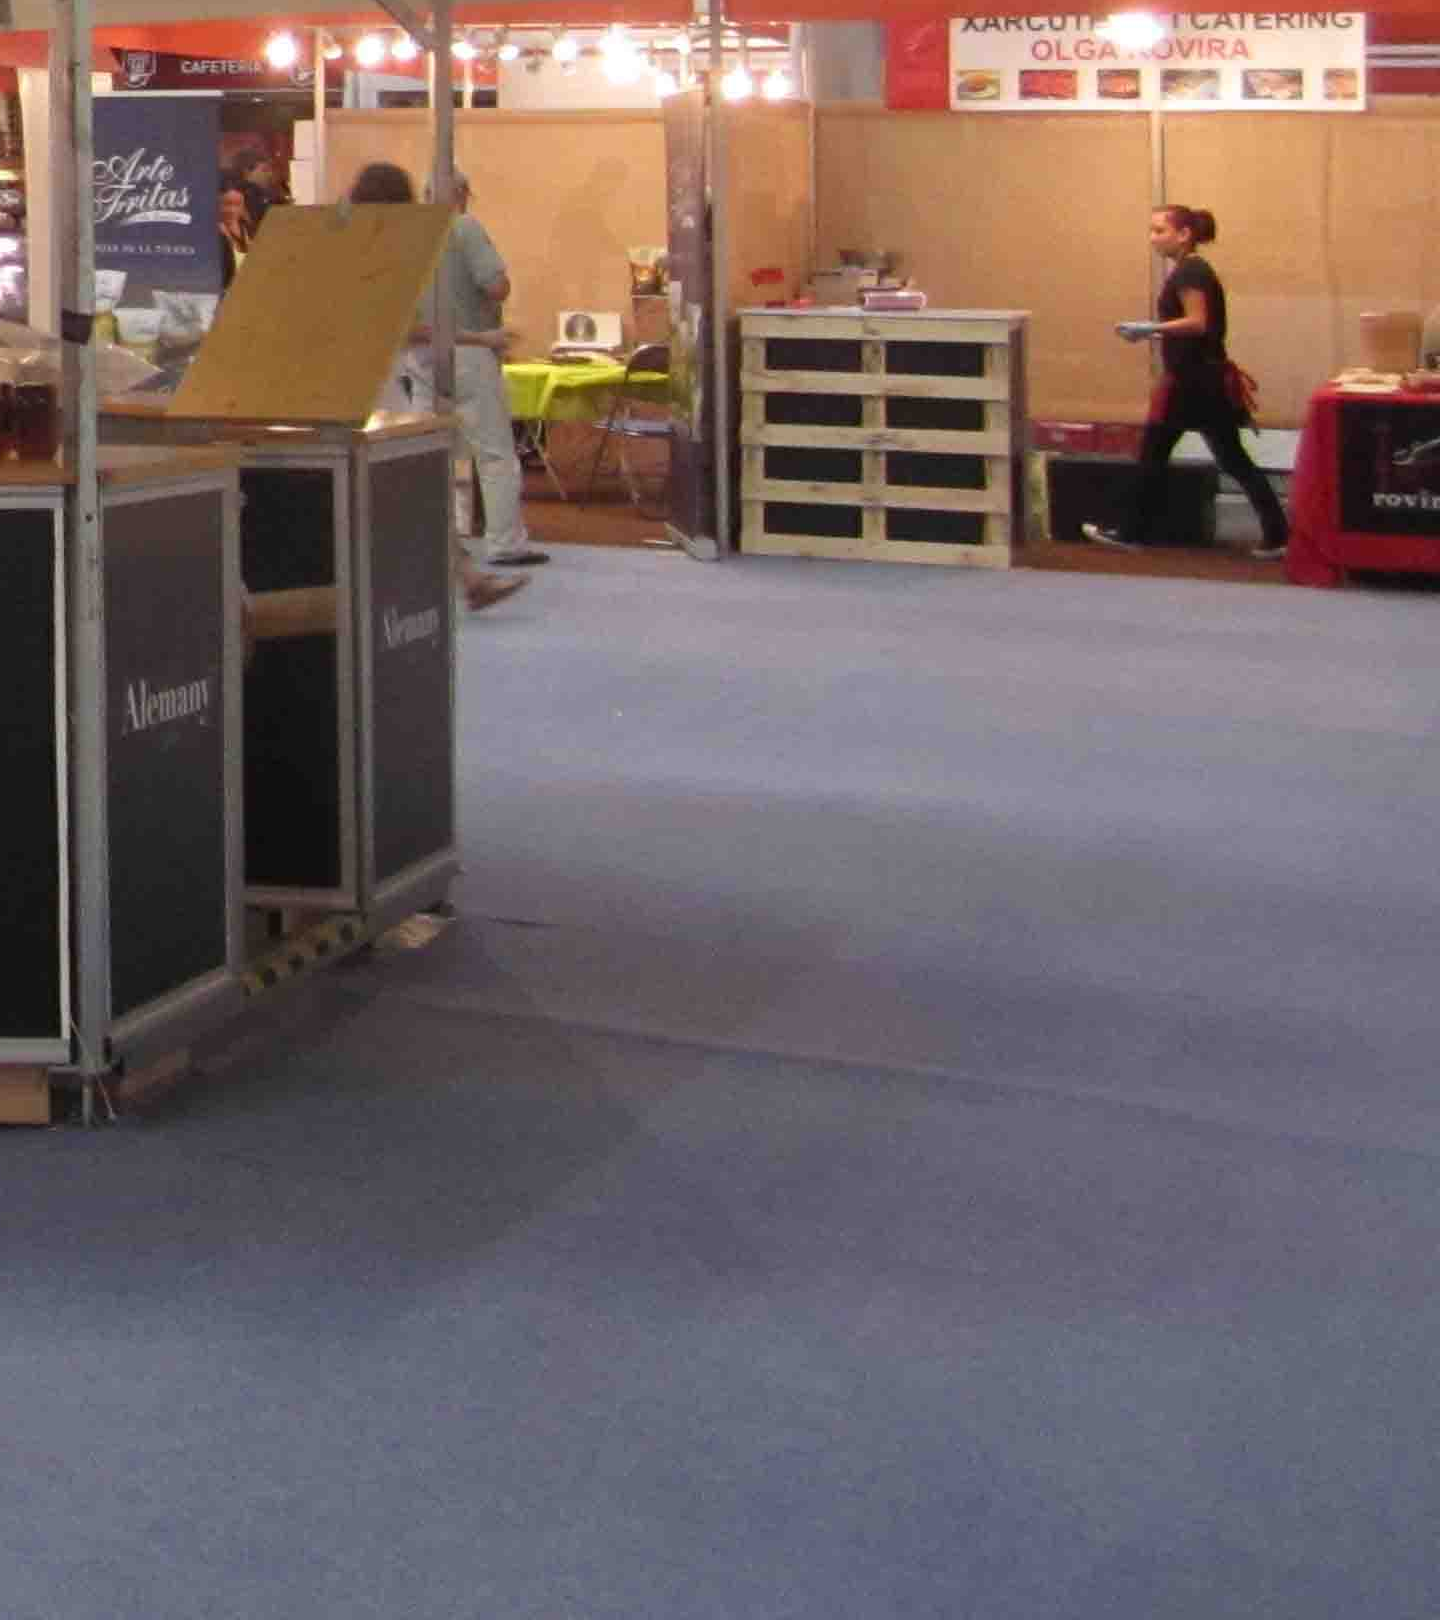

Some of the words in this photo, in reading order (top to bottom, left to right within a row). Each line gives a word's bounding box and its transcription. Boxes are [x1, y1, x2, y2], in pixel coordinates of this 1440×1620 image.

[1030, 38, 1119, 62] OLGA
[93, 147, 175, 189] Arte
[120, 678, 213, 737] Alemany
